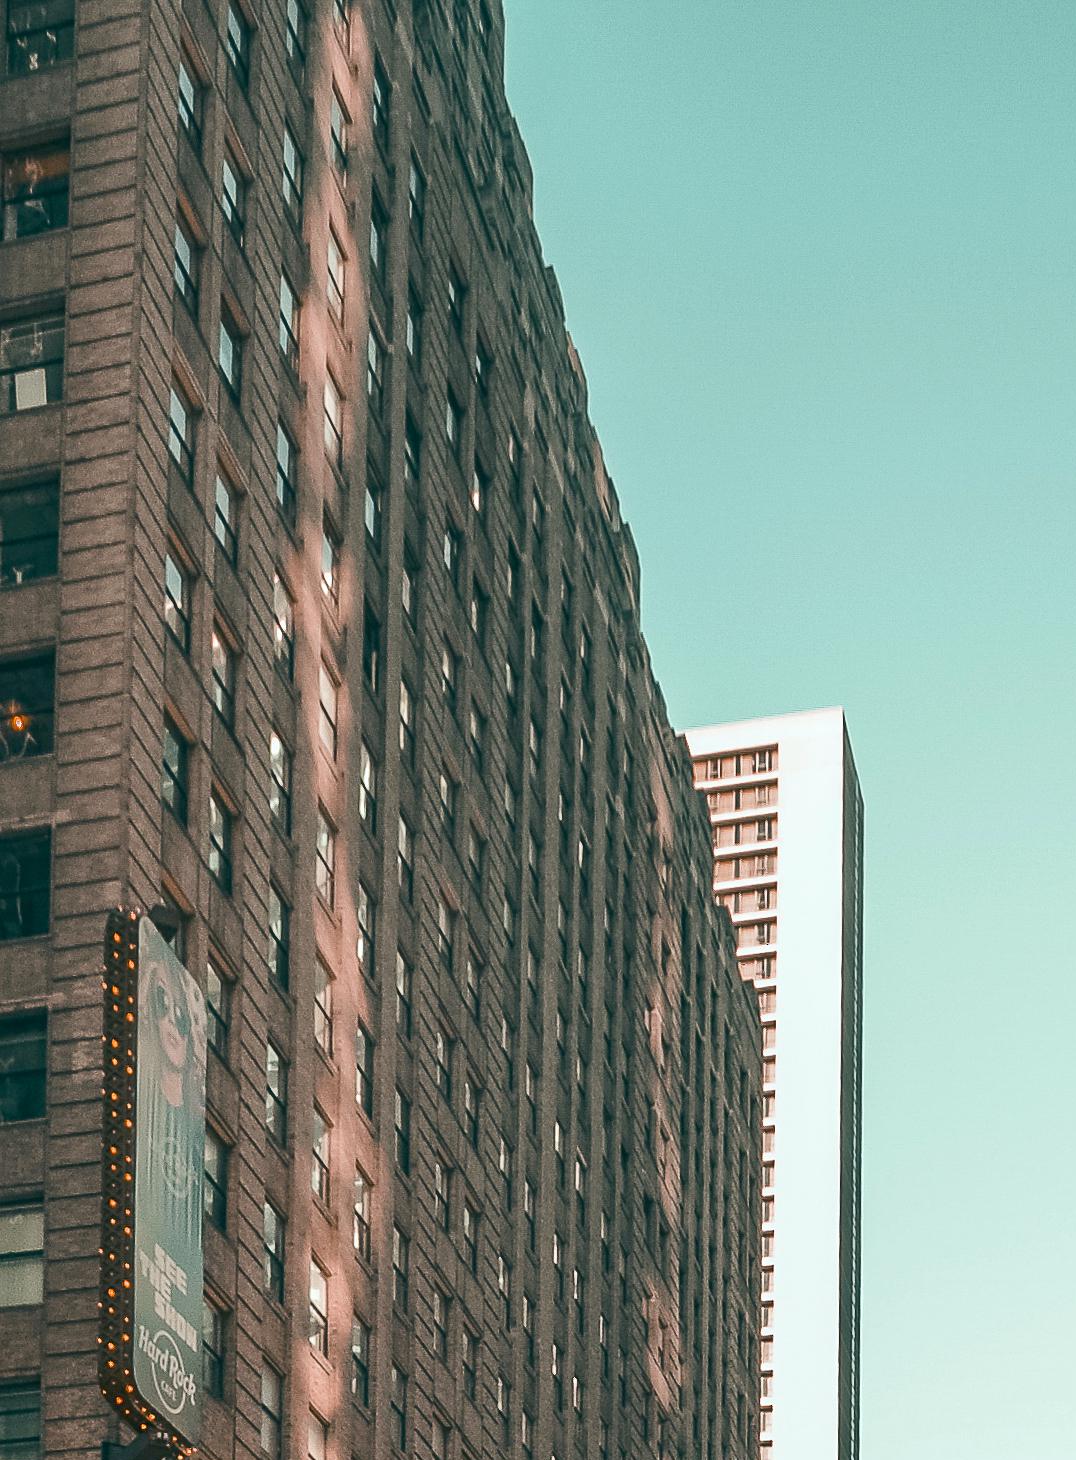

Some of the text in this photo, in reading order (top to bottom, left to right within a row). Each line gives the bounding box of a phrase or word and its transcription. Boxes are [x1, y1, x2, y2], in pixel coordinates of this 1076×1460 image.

[155, 1243, 187, 1296] SEE
[155, 1291, 197, 1352] SHOW
[138, 1325, 196, 1406] Hard Rock
